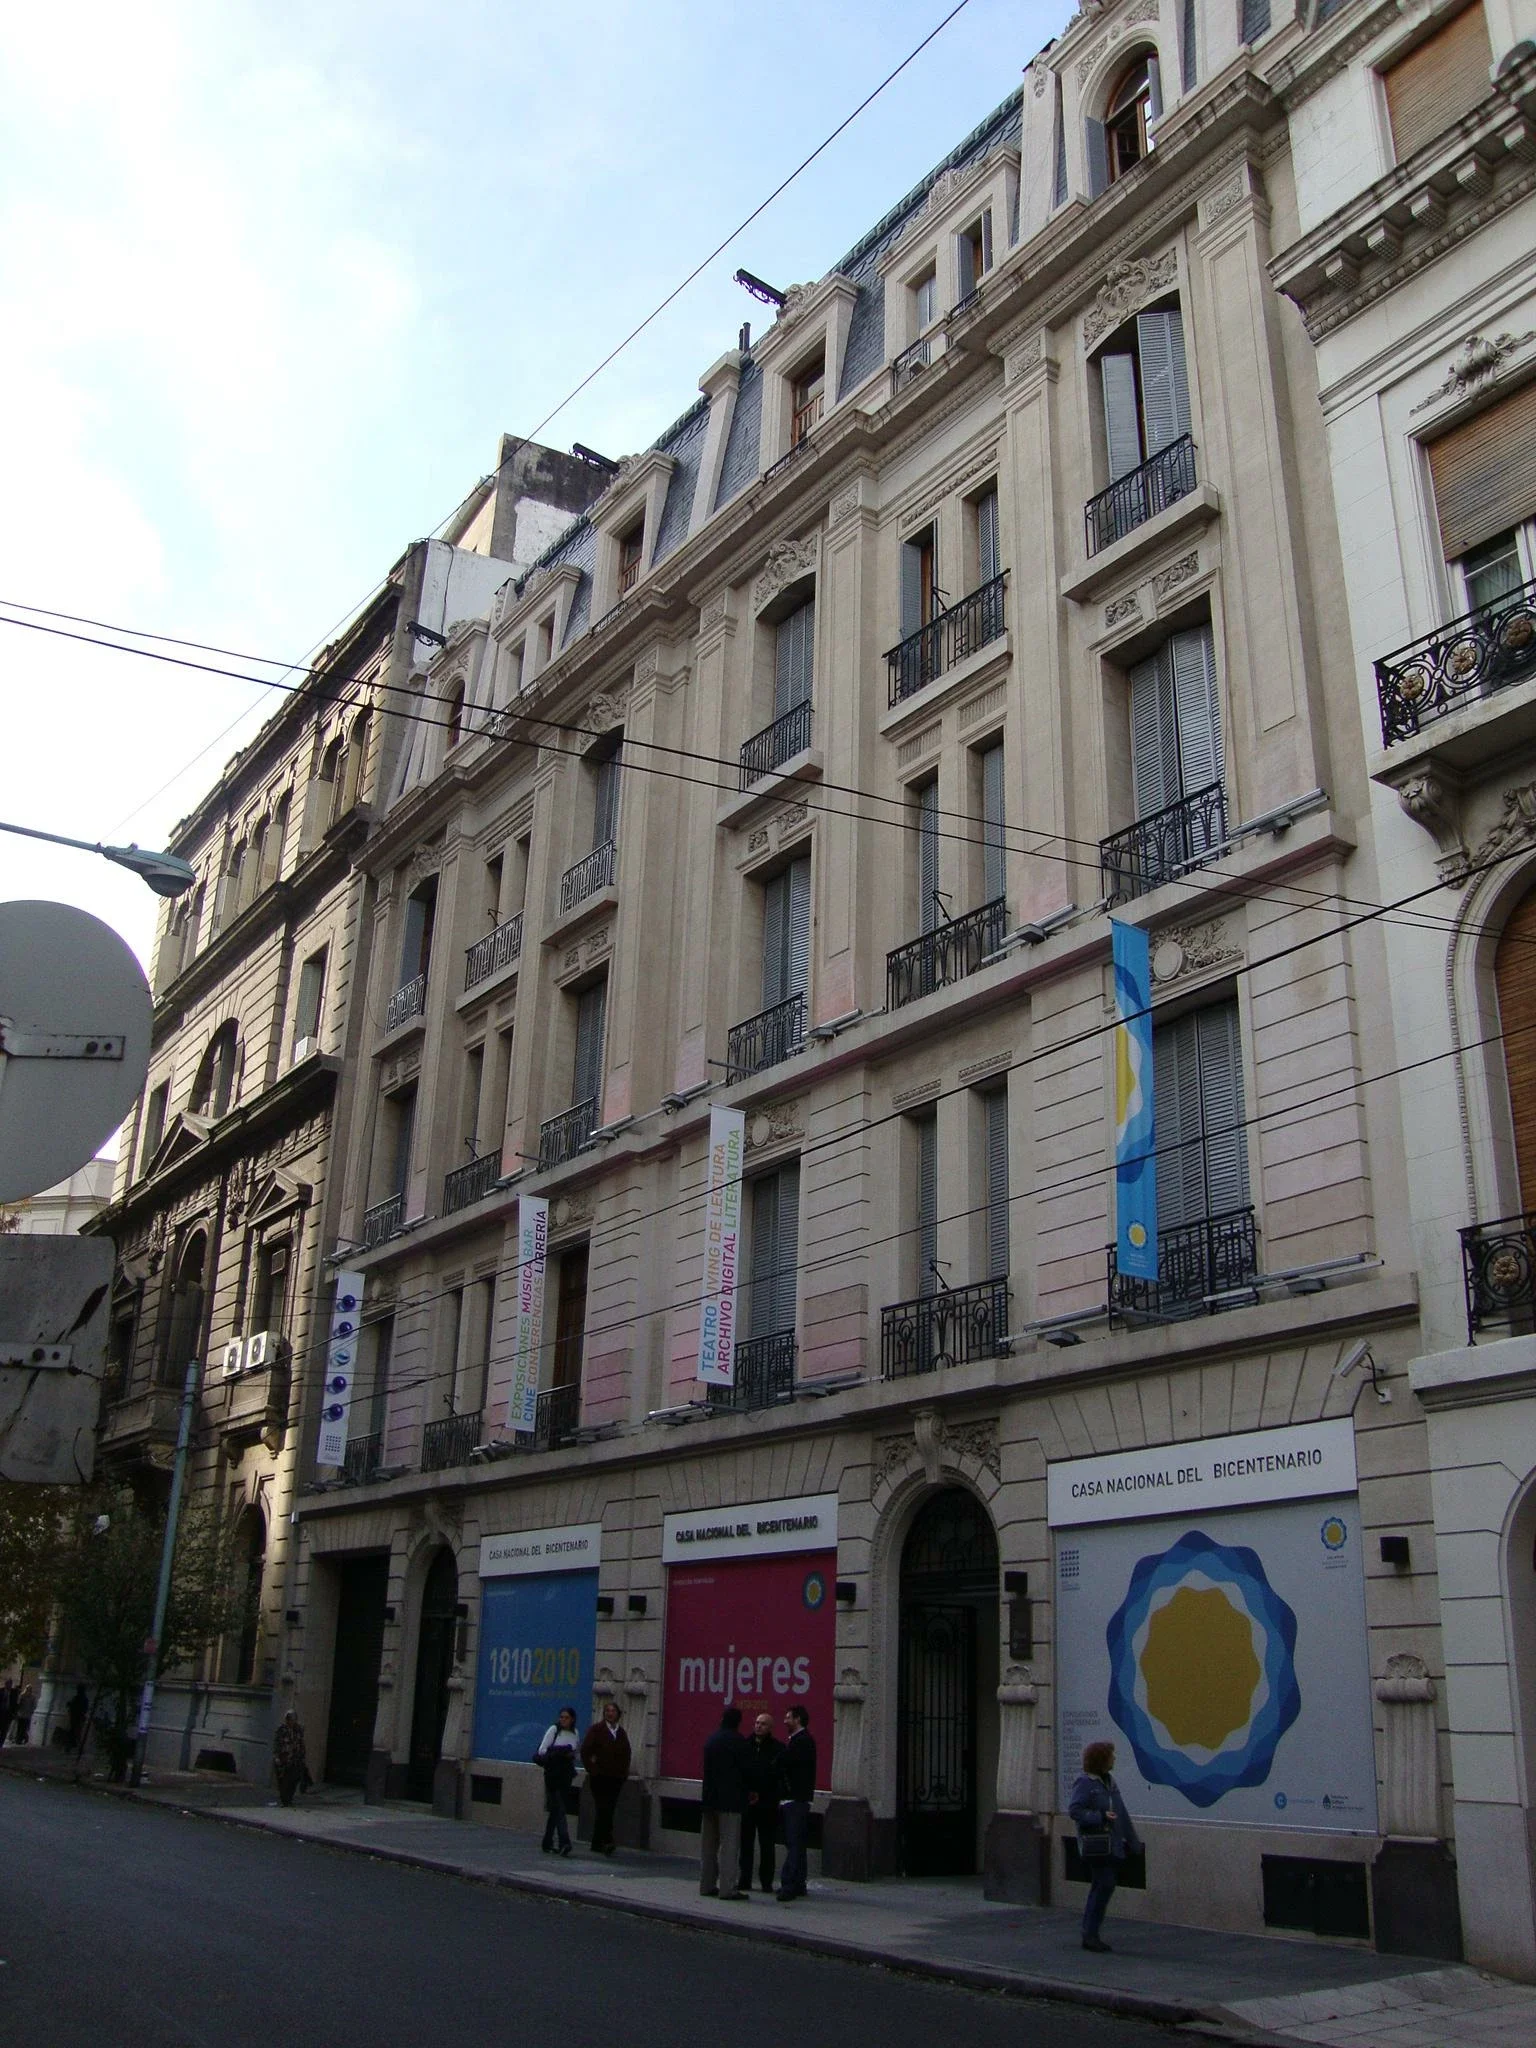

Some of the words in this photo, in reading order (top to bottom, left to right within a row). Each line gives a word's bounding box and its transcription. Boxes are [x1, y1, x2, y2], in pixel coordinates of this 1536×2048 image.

[711, 1144, 725, 1216] LECTURA
[725, 1130, 740, 1228] LITERATURA
[524, 1229, 533, 1257] BAR
[533, 1211, 546, 1274] LIBRERÍA
[709, 1221, 722, 1242] DE
[520, 1261, 533, 1313] MÚSICA
[707, 1248, 721, 1301] LIVING
[721, 1233, 736, 1296] DIGITAL
[528, 1278, 543, 1384] CONFERENCIAS
[702, 1306, 717, 1371] TEATRO
[718, 1301, 733, 1375] ARCHIVO
[512, 1318, 530, 1420] EXPOSICIONES
[523, 1388, 536, 1422] CINE
[1071, 1481, 1103, 1498] CASA
[1107, 1471, 1173, 1494] NACIONAL
[1178, 1467, 1203, 1484] DEL
[1213, 1449, 1323, 1479] BICENTENARIO
[489, 1550, 502, 1560] CASA
[503, 1546, 530, 1559] NACIONAL
[531, 1545, 541, 1556] DEL
[545, 1540, 589, 1554] BICENTENARIO
[676, 1530, 695, 1543] CASA
[696, 1525, 735, 1541] NACIONAL
[736, 1523, 752, 1537] DEL
[757, 1515, 819, 1535] BICENTENARIO
[679, 1644, 811, 1706] mujeres
